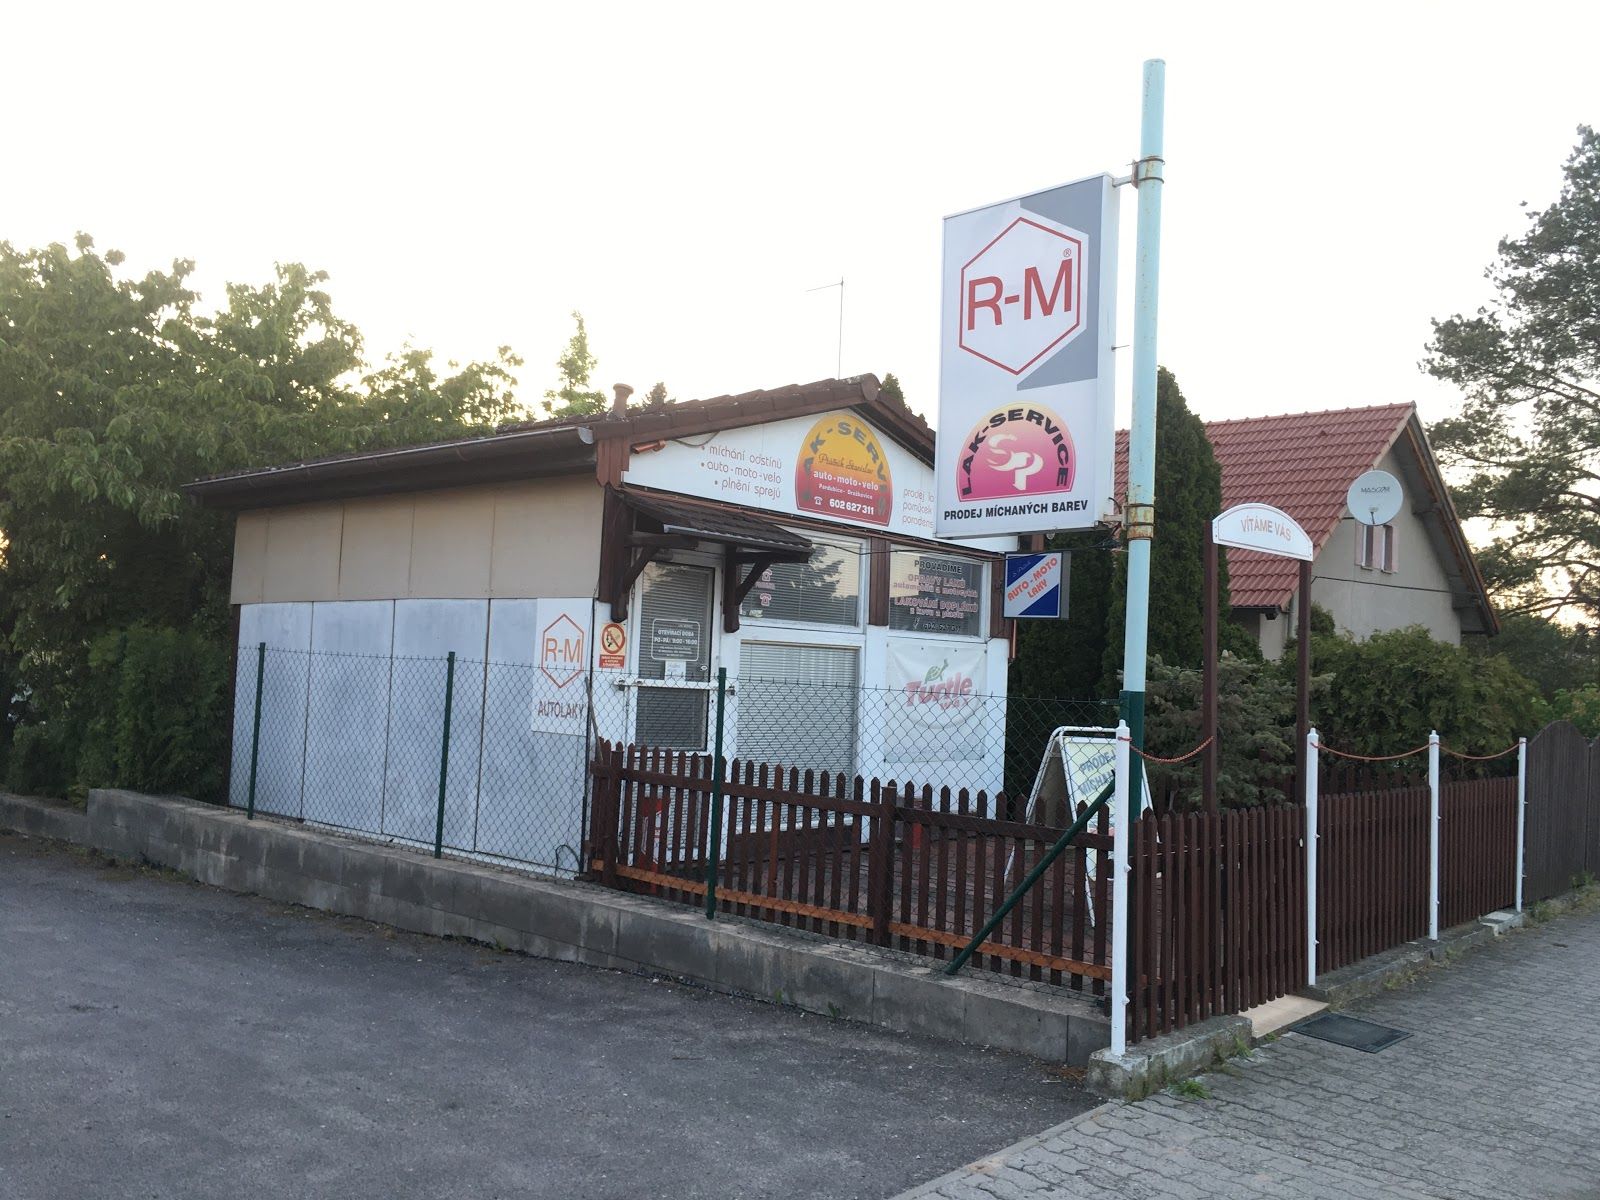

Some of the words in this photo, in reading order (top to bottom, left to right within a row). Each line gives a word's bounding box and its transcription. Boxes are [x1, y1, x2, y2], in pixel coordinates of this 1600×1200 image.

[967, 258, 1073, 331] R-M
[709, 445, 746, 461] míchání
[962, 408, 1069, 496] LAK-SERVICE
[721, 477, 751, 492] plnění
[829, 498, 845, 509] 602
[846, 500, 861, 512] 627
[862, 504, 875, 515] 311
[944, 508, 982, 520] PRODEJ
[985, 502, 1048, 518] MÍCHANÝCH
[1051, 500, 1088, 513] BAREV
[1240, 515, 1273, 534] VÍTÁME
[1275, 520, 1292, 542] VÁS
[1007, 580, 1029, 601] AUTO
[1033, 557, 1058, 581] MOTO
[1027, 578, 1048, 598] LAKY
[545, 637, 581, 663] R-M
[905, 672, 973, 707] Turtle
[537, 701, 585, 719] AUTOLAKY
